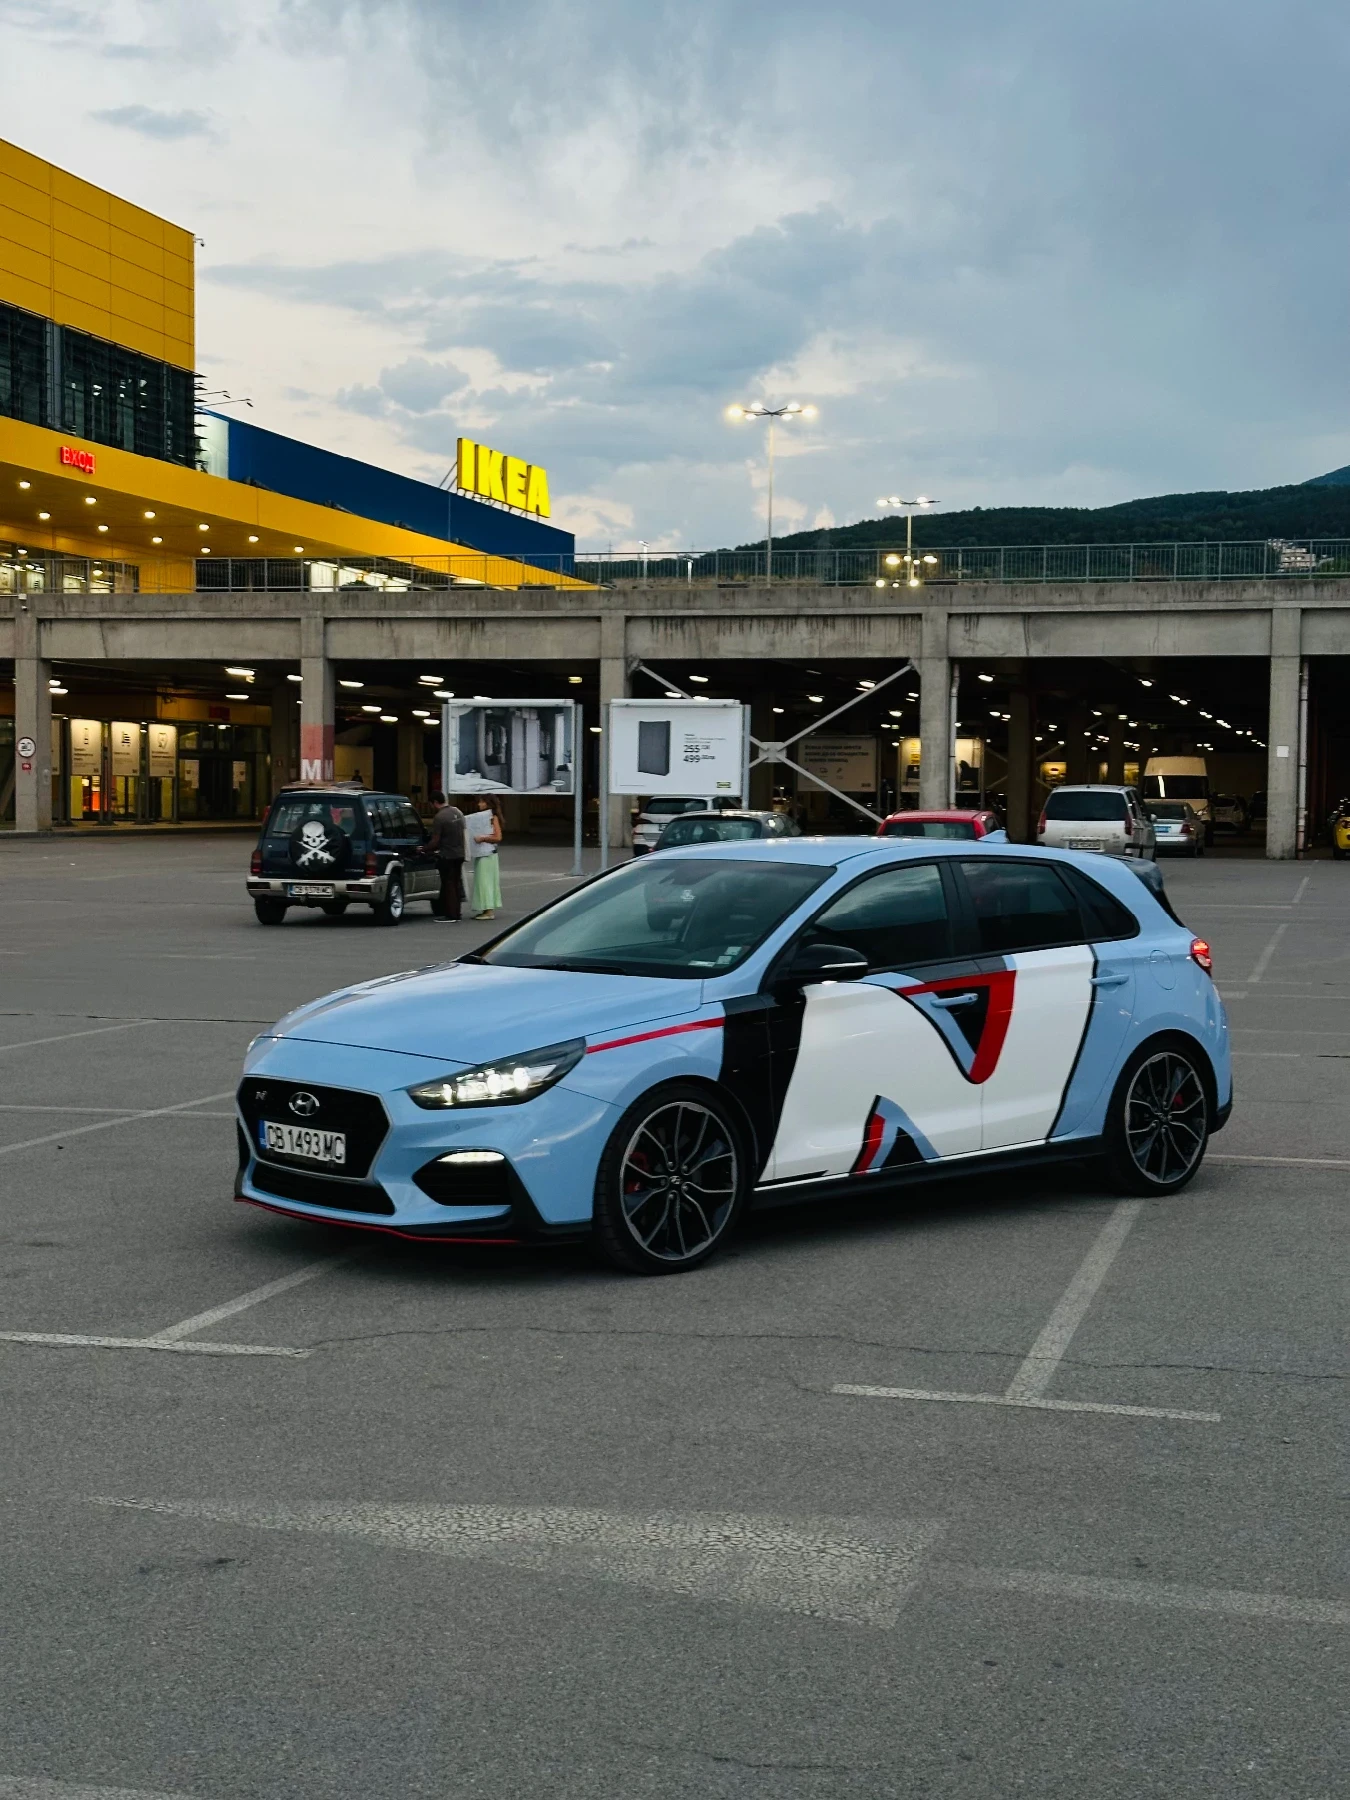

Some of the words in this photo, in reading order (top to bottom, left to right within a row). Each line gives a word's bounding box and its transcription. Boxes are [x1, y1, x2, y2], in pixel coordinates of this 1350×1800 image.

[60, 446, 96, 475] ВХОД
[457, 437, 550, 518] IKEA
[683, 744, 701, 753] 255
[683, 754, 701, 763] 499
[300, 759, 322, 781] M
[267, 1124, 286, 1150] CB
[288, 1128, 321, 1156] 1493
[323, 1133, 346, 1160] MC
